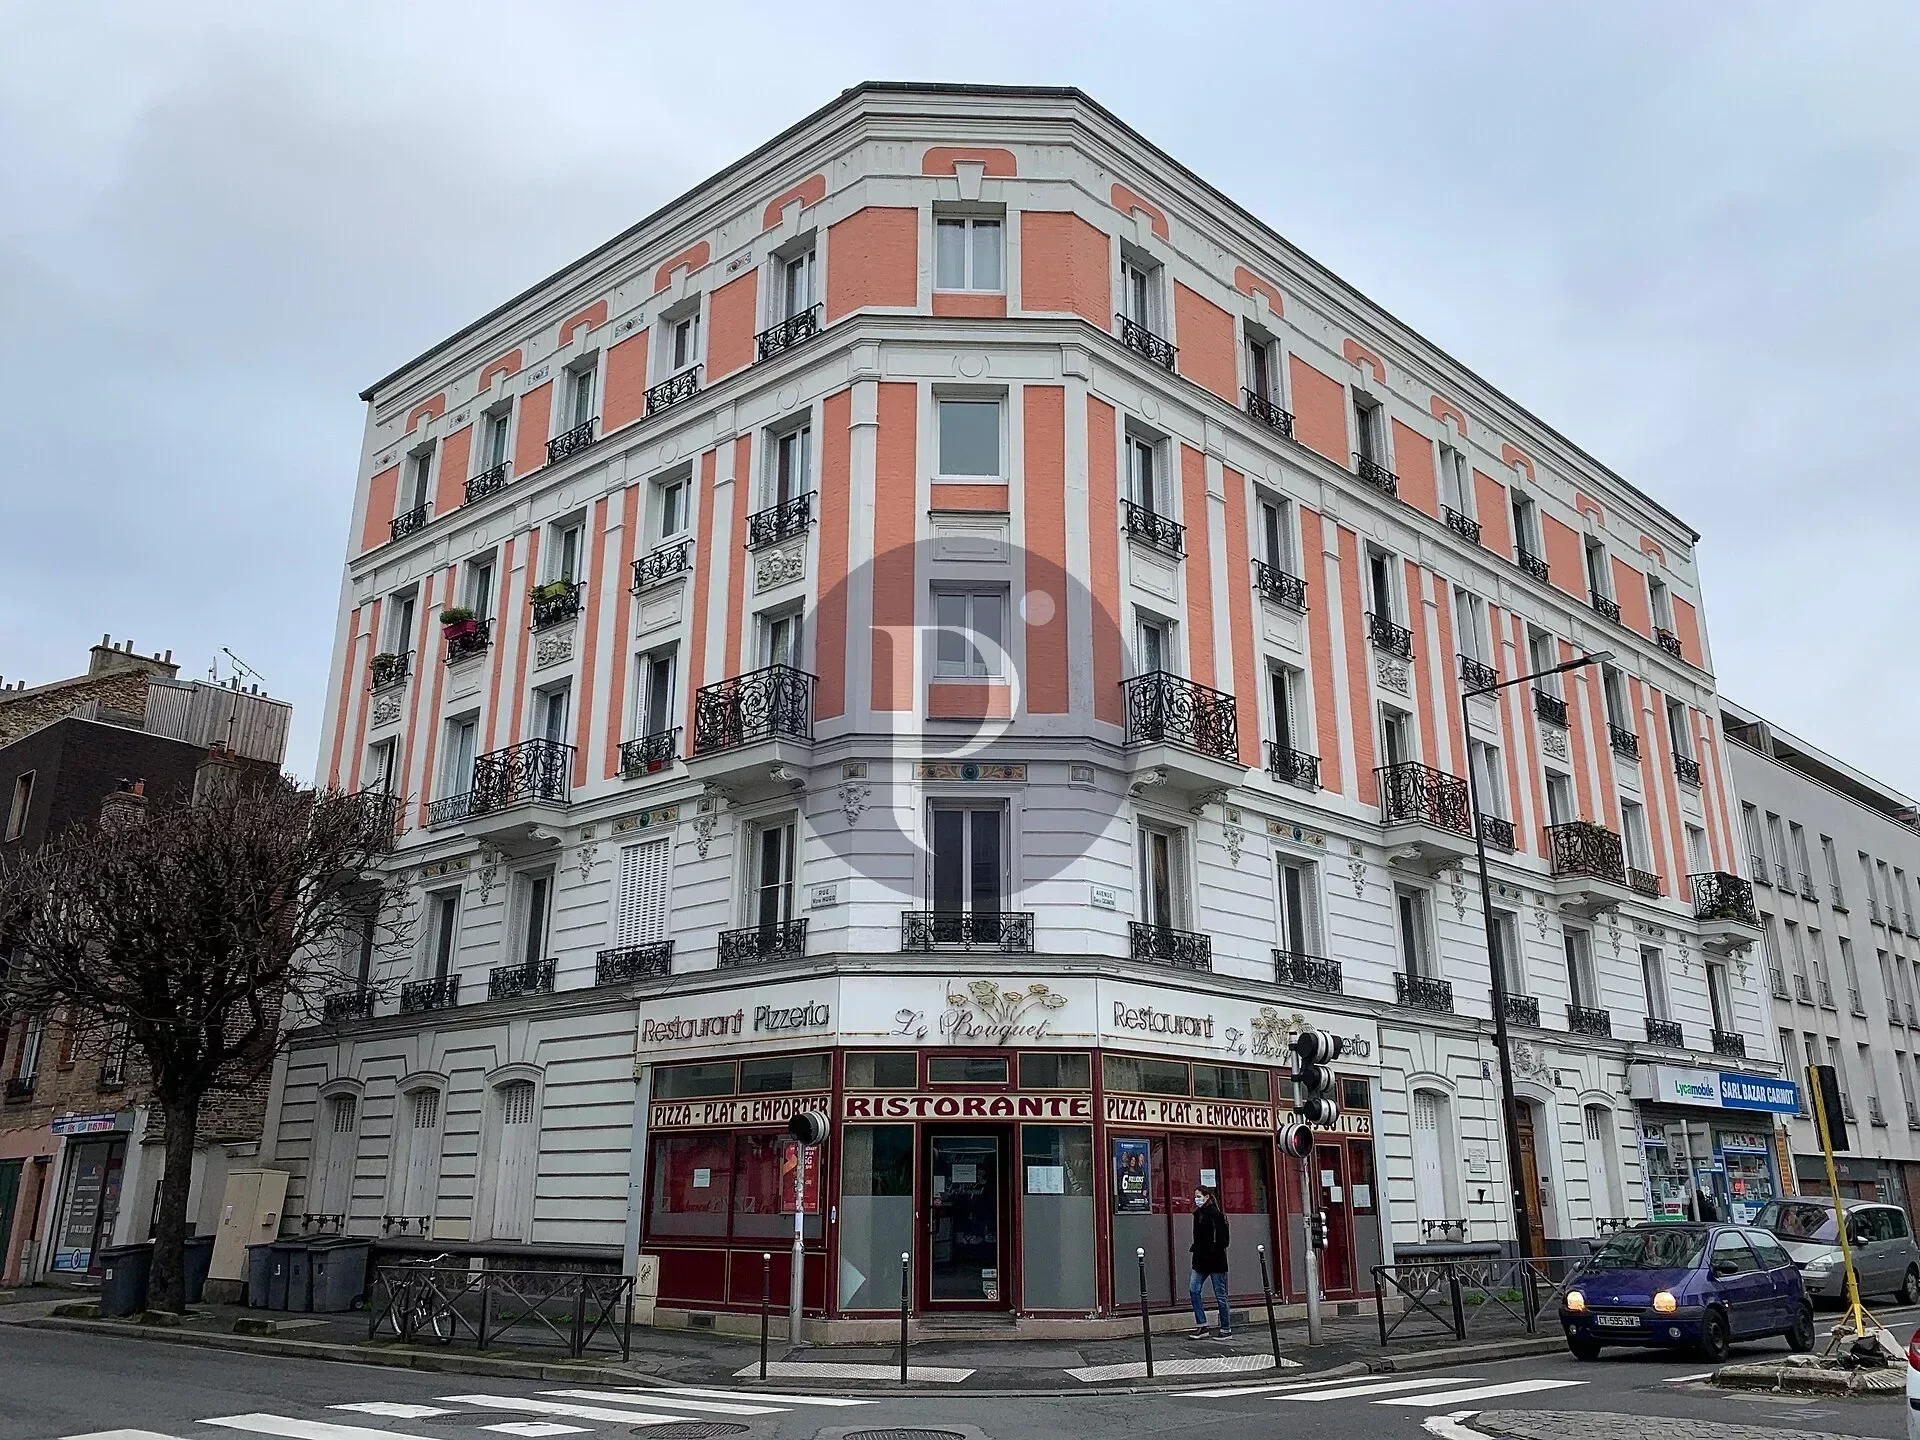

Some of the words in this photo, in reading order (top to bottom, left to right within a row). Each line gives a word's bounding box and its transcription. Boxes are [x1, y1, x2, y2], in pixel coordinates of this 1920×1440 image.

[642, 1008, 744, 1042] Restaurant
[754, 1000, 830, 1032] Pizzeria
[891, 1008, 928, 1040] Le
[1113, 1001, 1215, 1038] Restaurant
[1223, 1027, 1248, 1055] Le
[1674, 1080, 1714, 1097] Lycamobile
[1721, 1080, 1742, 1099] SARL
[1742, 1083, 1767, 1103] BAZAR
[655, 1105, 692, 1126] PIZZA
[704, 1102, 738, 1124] PLAT
[846, 1096, 1091, 1117] RISTORANTE
[1107, 1098, 1148, 1121] PIZZA
[1160, 1102, 1192, 1124] PLAT
[1206, 1105, 1270, 1128] EMPORTER
[1356, 1117, 1370, 1133] 23
[1122, 1174, 1129, 1190] 6
